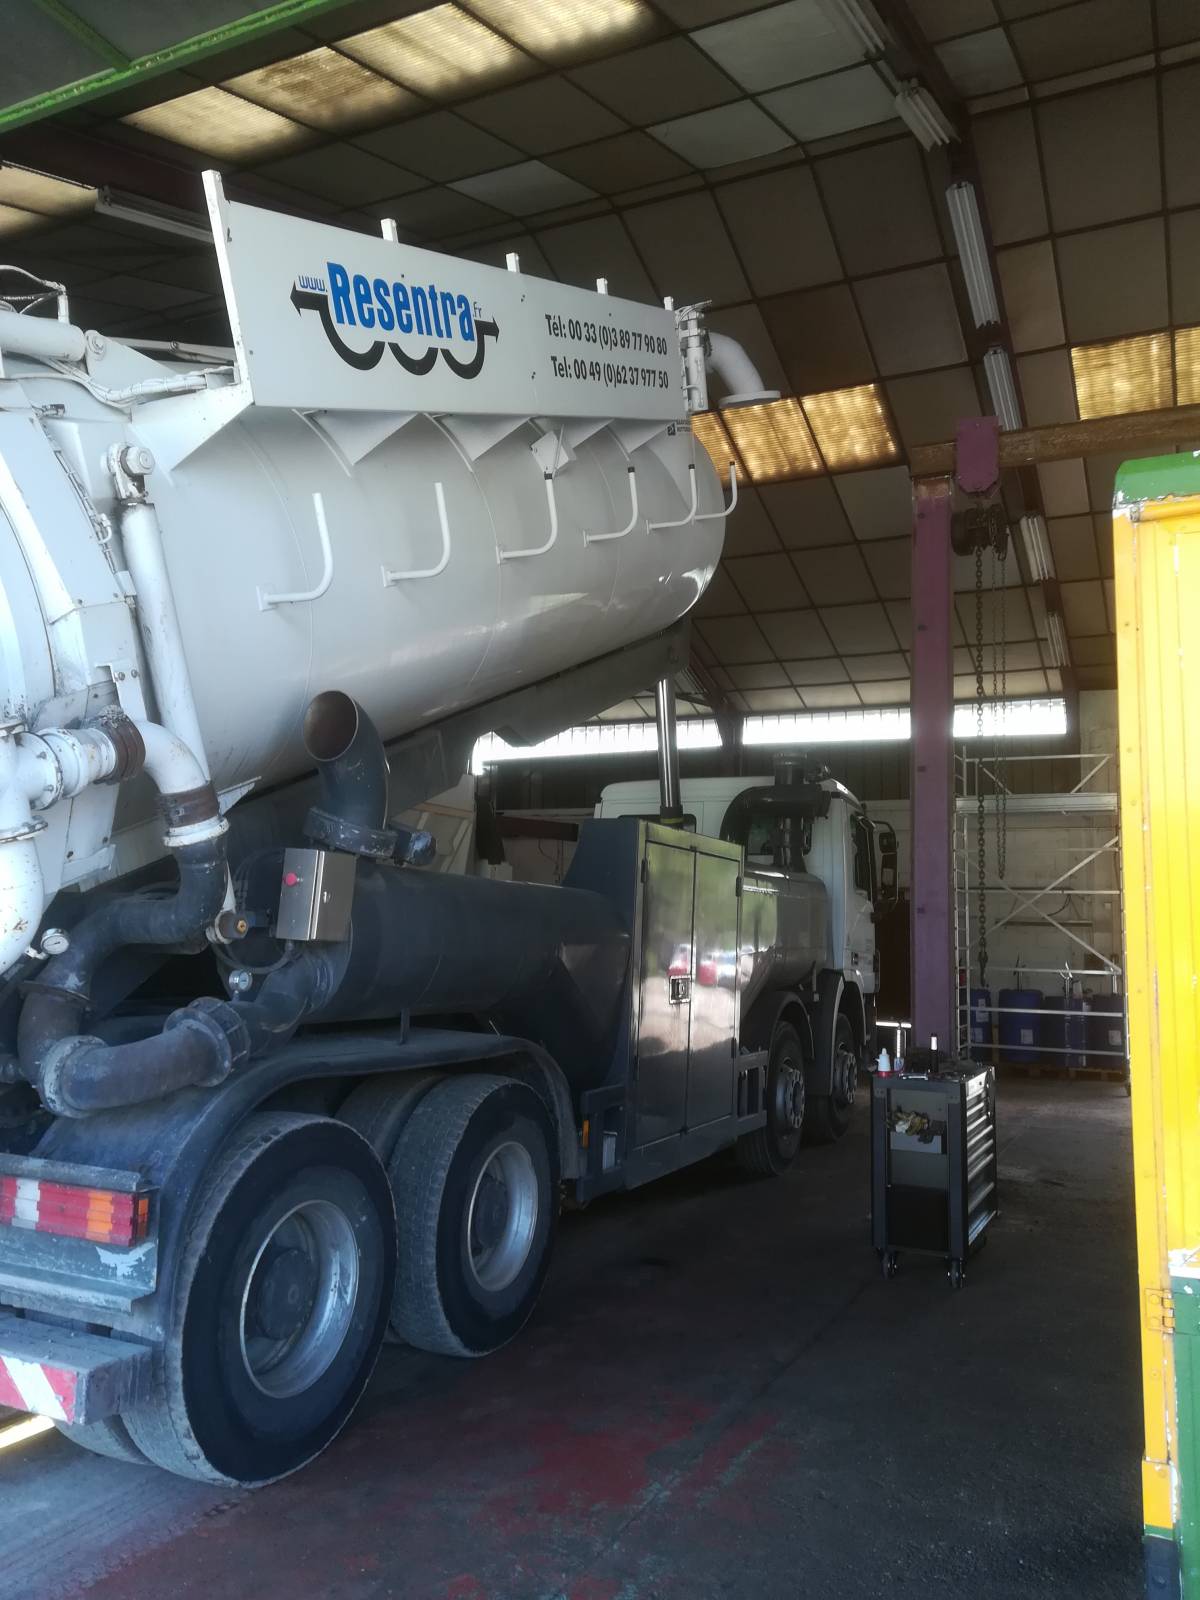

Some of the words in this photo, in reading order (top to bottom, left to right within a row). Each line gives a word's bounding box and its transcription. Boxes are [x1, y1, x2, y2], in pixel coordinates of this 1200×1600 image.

[327, 261, 475, 342] Resentra
[545, 314, 567, 338] Tél:
[568, 318, 582, 341] 00
[583, 322, 598, 343] 33
[619, 329, 631, 349] 89
[632, 332, 643, 351] 77
[644, 334, 656, 354] 90
[656, 337, 668, 355] 80
[551, 356, 573, 379] Tel:
[573, 359, 587, 380] 00
[589, 361, 601, 381] 49
[629, 366, 640, 386] 37
[658, 371, 669, 389] 50
